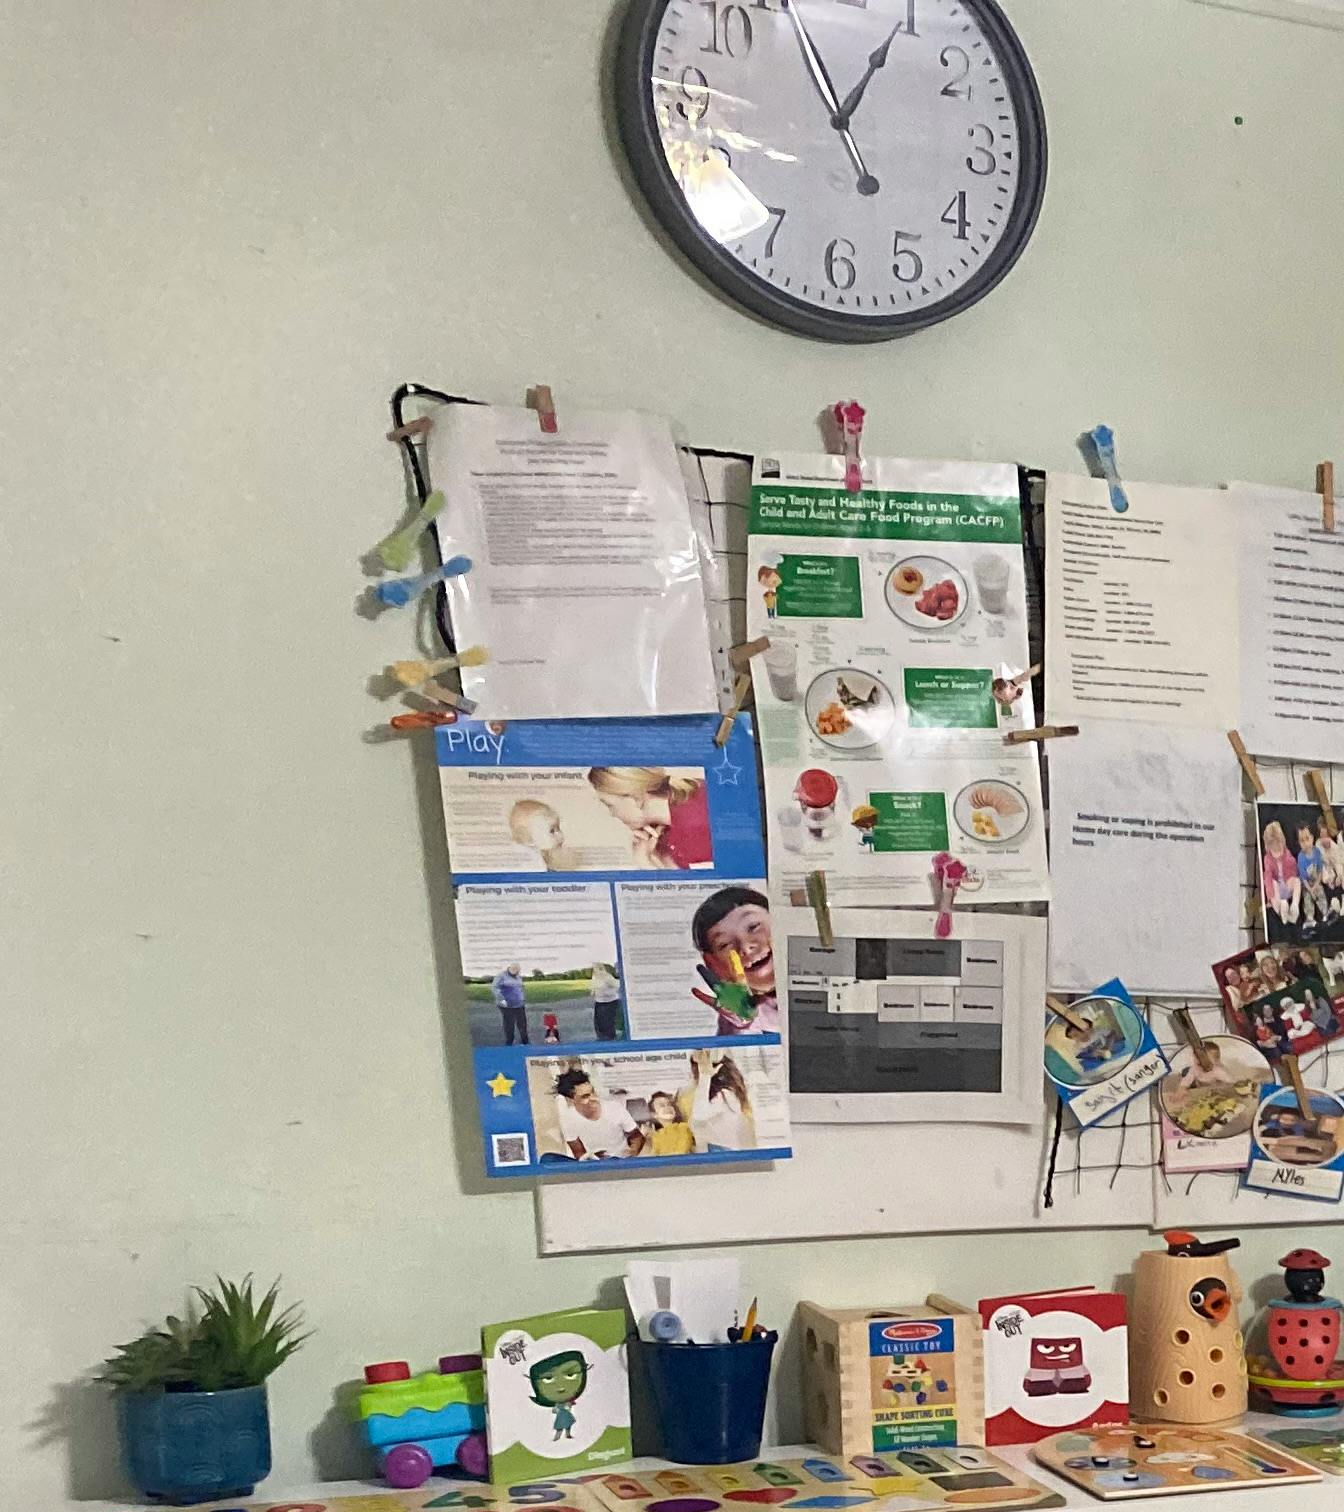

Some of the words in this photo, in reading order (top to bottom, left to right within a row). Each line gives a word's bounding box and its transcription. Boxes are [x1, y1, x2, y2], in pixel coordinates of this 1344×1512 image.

[700, 3, 753, 59] 10
[940, 46, 972, 102] 2
[965, 124, 997, 176] 3
[940, 190, 971, 240] 4
[766, 207, 787, 259] 7
[824, 237, 857, 290] 6
[892, 231, 924, 283] 5
[760, 493, 786, 505] Serve
[789, 494, 816, 508] Tasty
[818, 496, 836, 507] and
[839, 497, 886, 511] Healthy
[889, 499, 924, 511] Foods
[926, 501, 937, 511] in
[940, 501, 960, 512] the
[759, 506, 784, 518] Child
[786, 508, 806, 519] and
[808, 509, 836, 520] Adult
[839, 510, 867, 521] Care
[870, 511, 900, 522] Food
[903, 512, 953, 527] Program
[955, 514, 1004, 528] (CACFP)
[468, 771, 505, 781] Playing
[531, 772, 551, 781] your
[554, 772, 582, 780] infant
[1072, 825, 1096, 834] Home
[1097, 826, 1112, 837] day
[1112, 829, 1129, 837] care
[1130, 830, 1154, 841] during
[1155, 832, 1168, 840] the
[1169, 833, 1205, 843] operation
[1154, 819, 1193, 830] prohibited
[1072, 837, 1094, 847] hours
[466, 886, 502, 896] Playing
[504, 886, 526, 895] with
[528, 887, 549, 896] your
[655, 882, 676, 891] with
[678, 883, 698, 892] your
[613, 1055, 643, 1064] school
[645, 1055, 662, 1063] age
[663, 1052, 687, 1061] child
[881, 1341, 920, 1354] CLASSIC
[923, 1340, 941, 1351] TOY
[875, 1411, 899, 1421] SHAPE
[900, 1409, 934, 1420] SORTING
[935, 1407, 954, 1417] CUBE
[507, 1483, 567, 1505] 5
